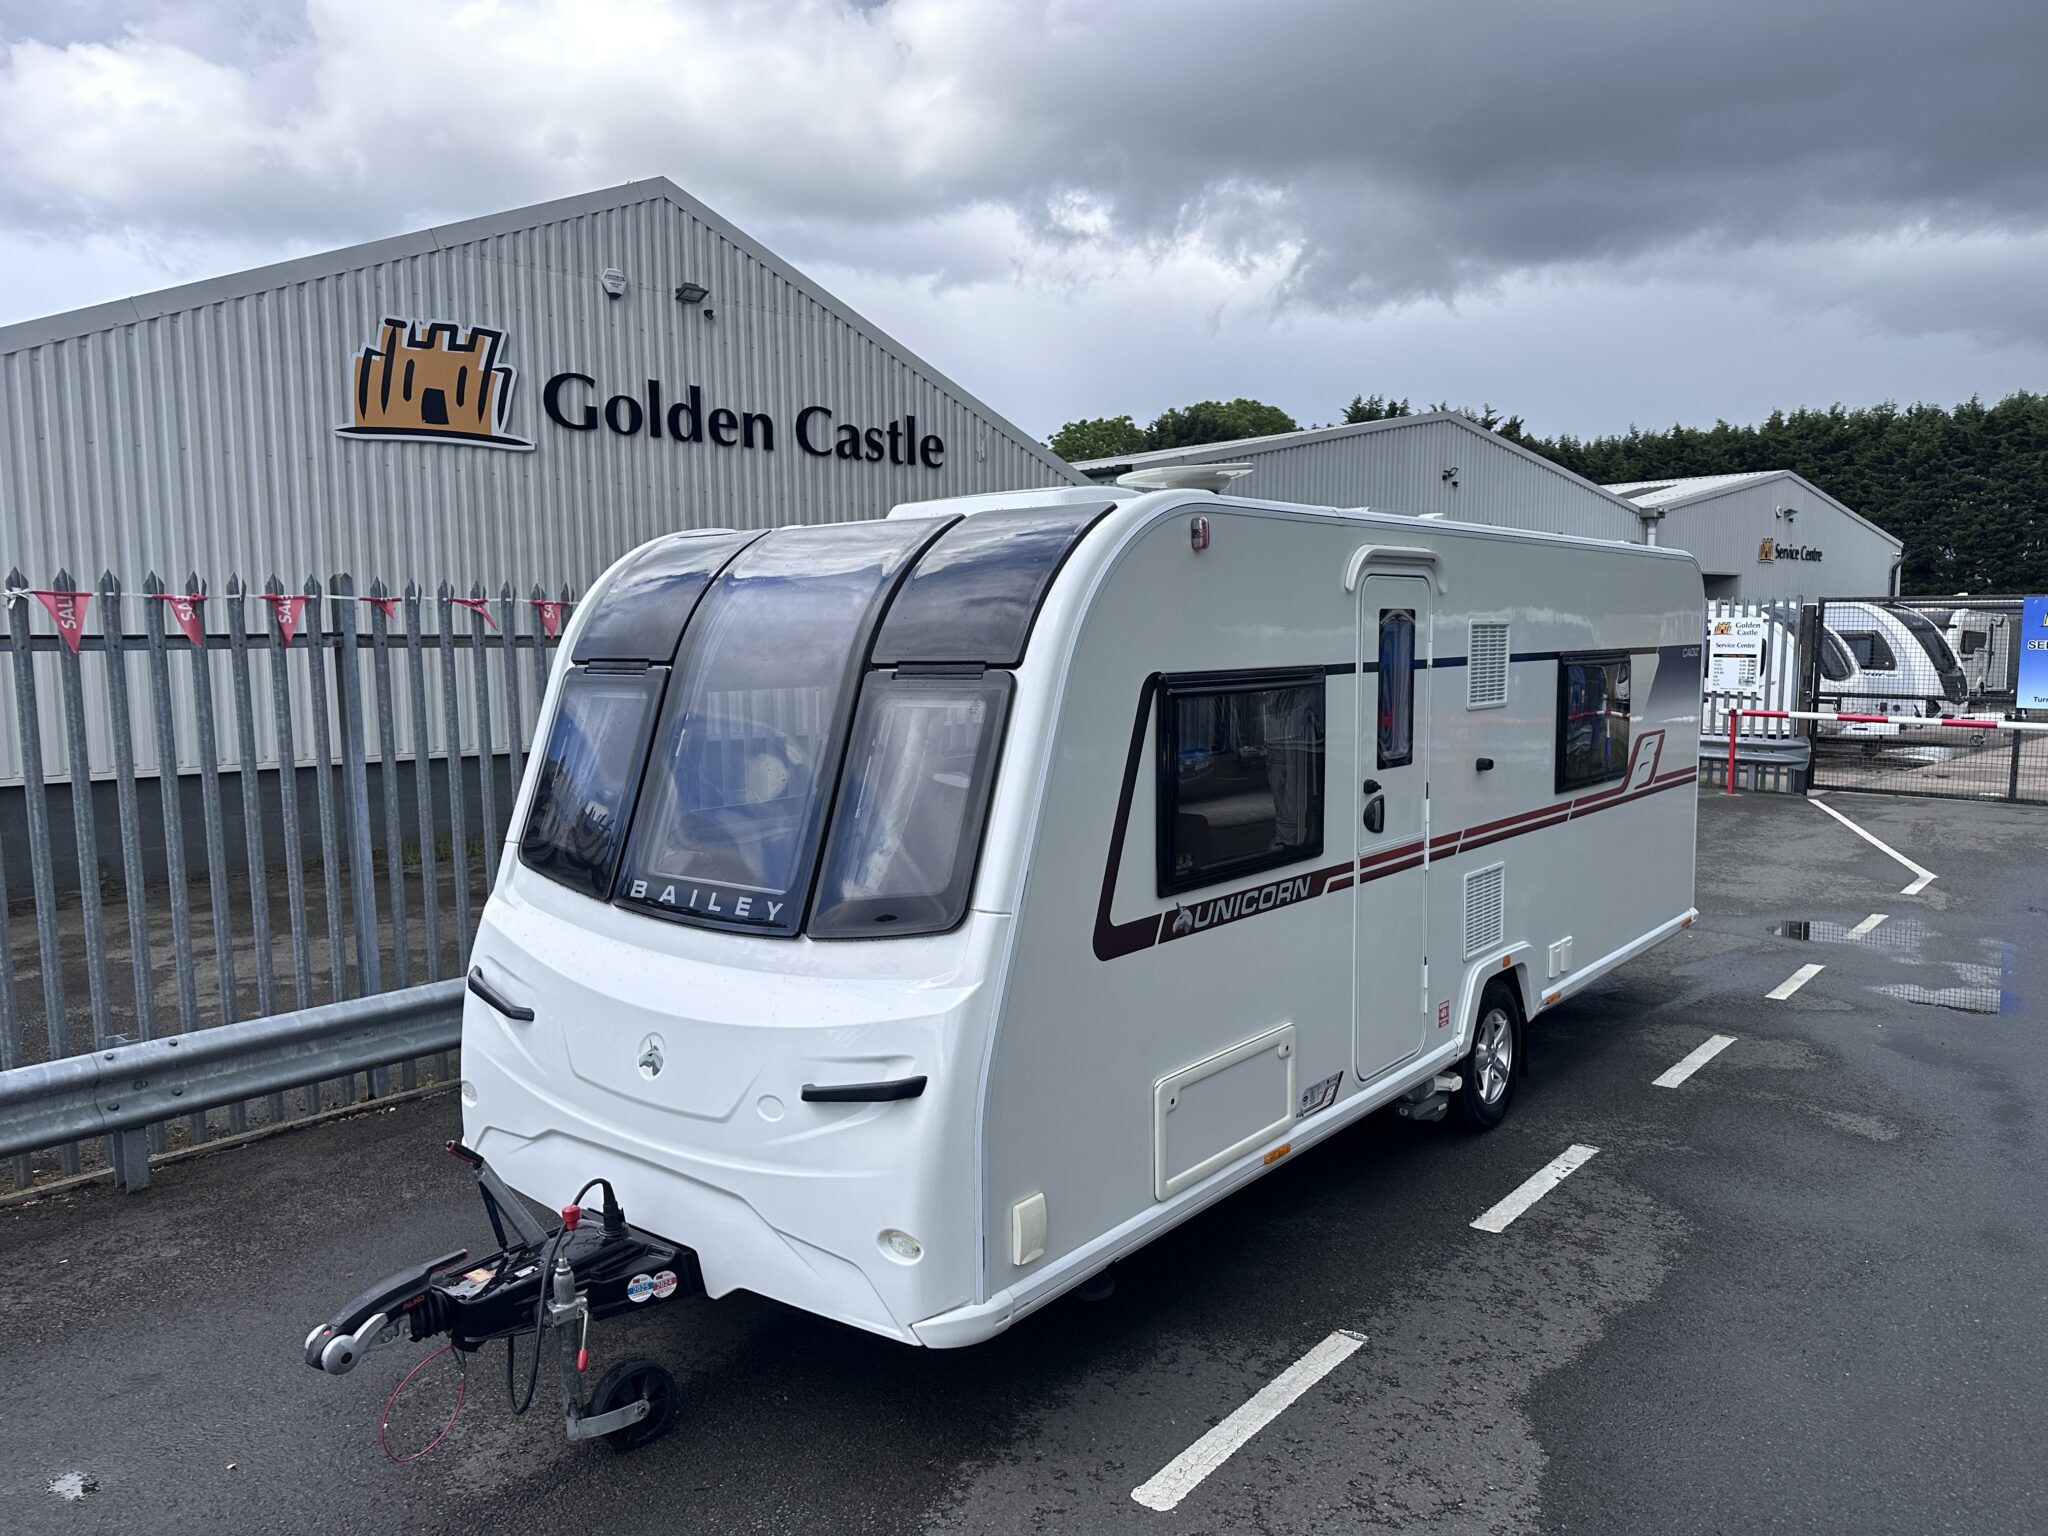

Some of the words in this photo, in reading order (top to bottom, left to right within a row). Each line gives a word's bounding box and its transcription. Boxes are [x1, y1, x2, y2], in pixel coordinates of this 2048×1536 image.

[543, 372, 774, 451] Golden
[795, 405, 944, 469] Castle
[1775, 543, 1800, 560] Service
[1801, 545, 1822, 562] Centre
[1735, 621, 1761, 629] Golden
[1682, 647, 1700, 658] CADIZ
[2028, 640, 2048, 650] SE
[630, 879, 784, 921] BAILEY
[1193, 876, 1311, 929] UNICORN
[656, 1279, 673, 1291] 2024
